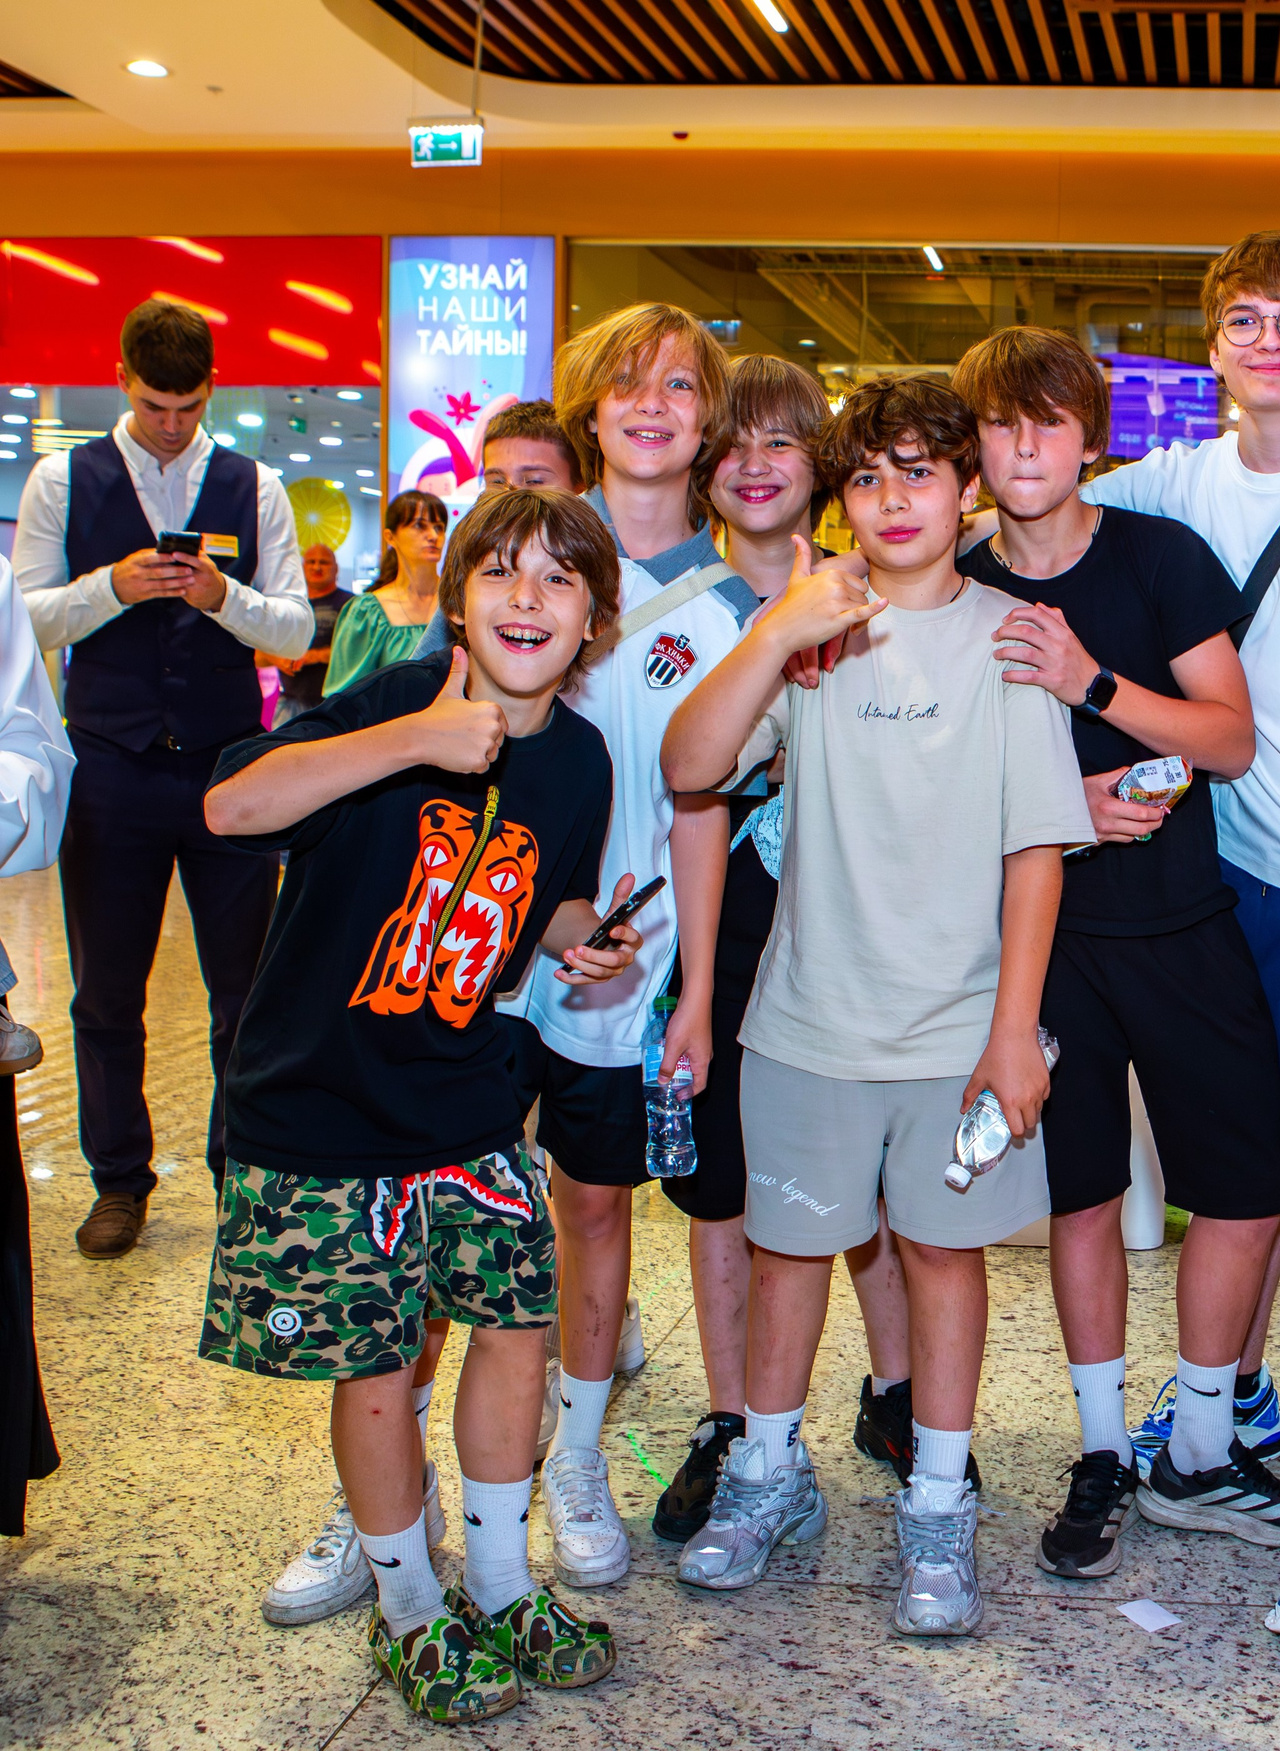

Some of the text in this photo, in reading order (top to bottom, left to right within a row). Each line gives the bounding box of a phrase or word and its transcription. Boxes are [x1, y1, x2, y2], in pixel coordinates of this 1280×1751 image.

[417, 258, 528, 290] УЗНАЙ
[418, 296, 527, 322] НАШИ
[416, 323, 528, 356] ТАЙНЫ!
[665, 646, 691, 671] ХИМКИ
[904, 702, 940, 721] Earth
[748, 1171, 840, 1217] new legend
[786, 1419, 801, 1448] FILA
[683, 1567, 699, 1579] 38
[922, 1616, 941, 1628] 38
